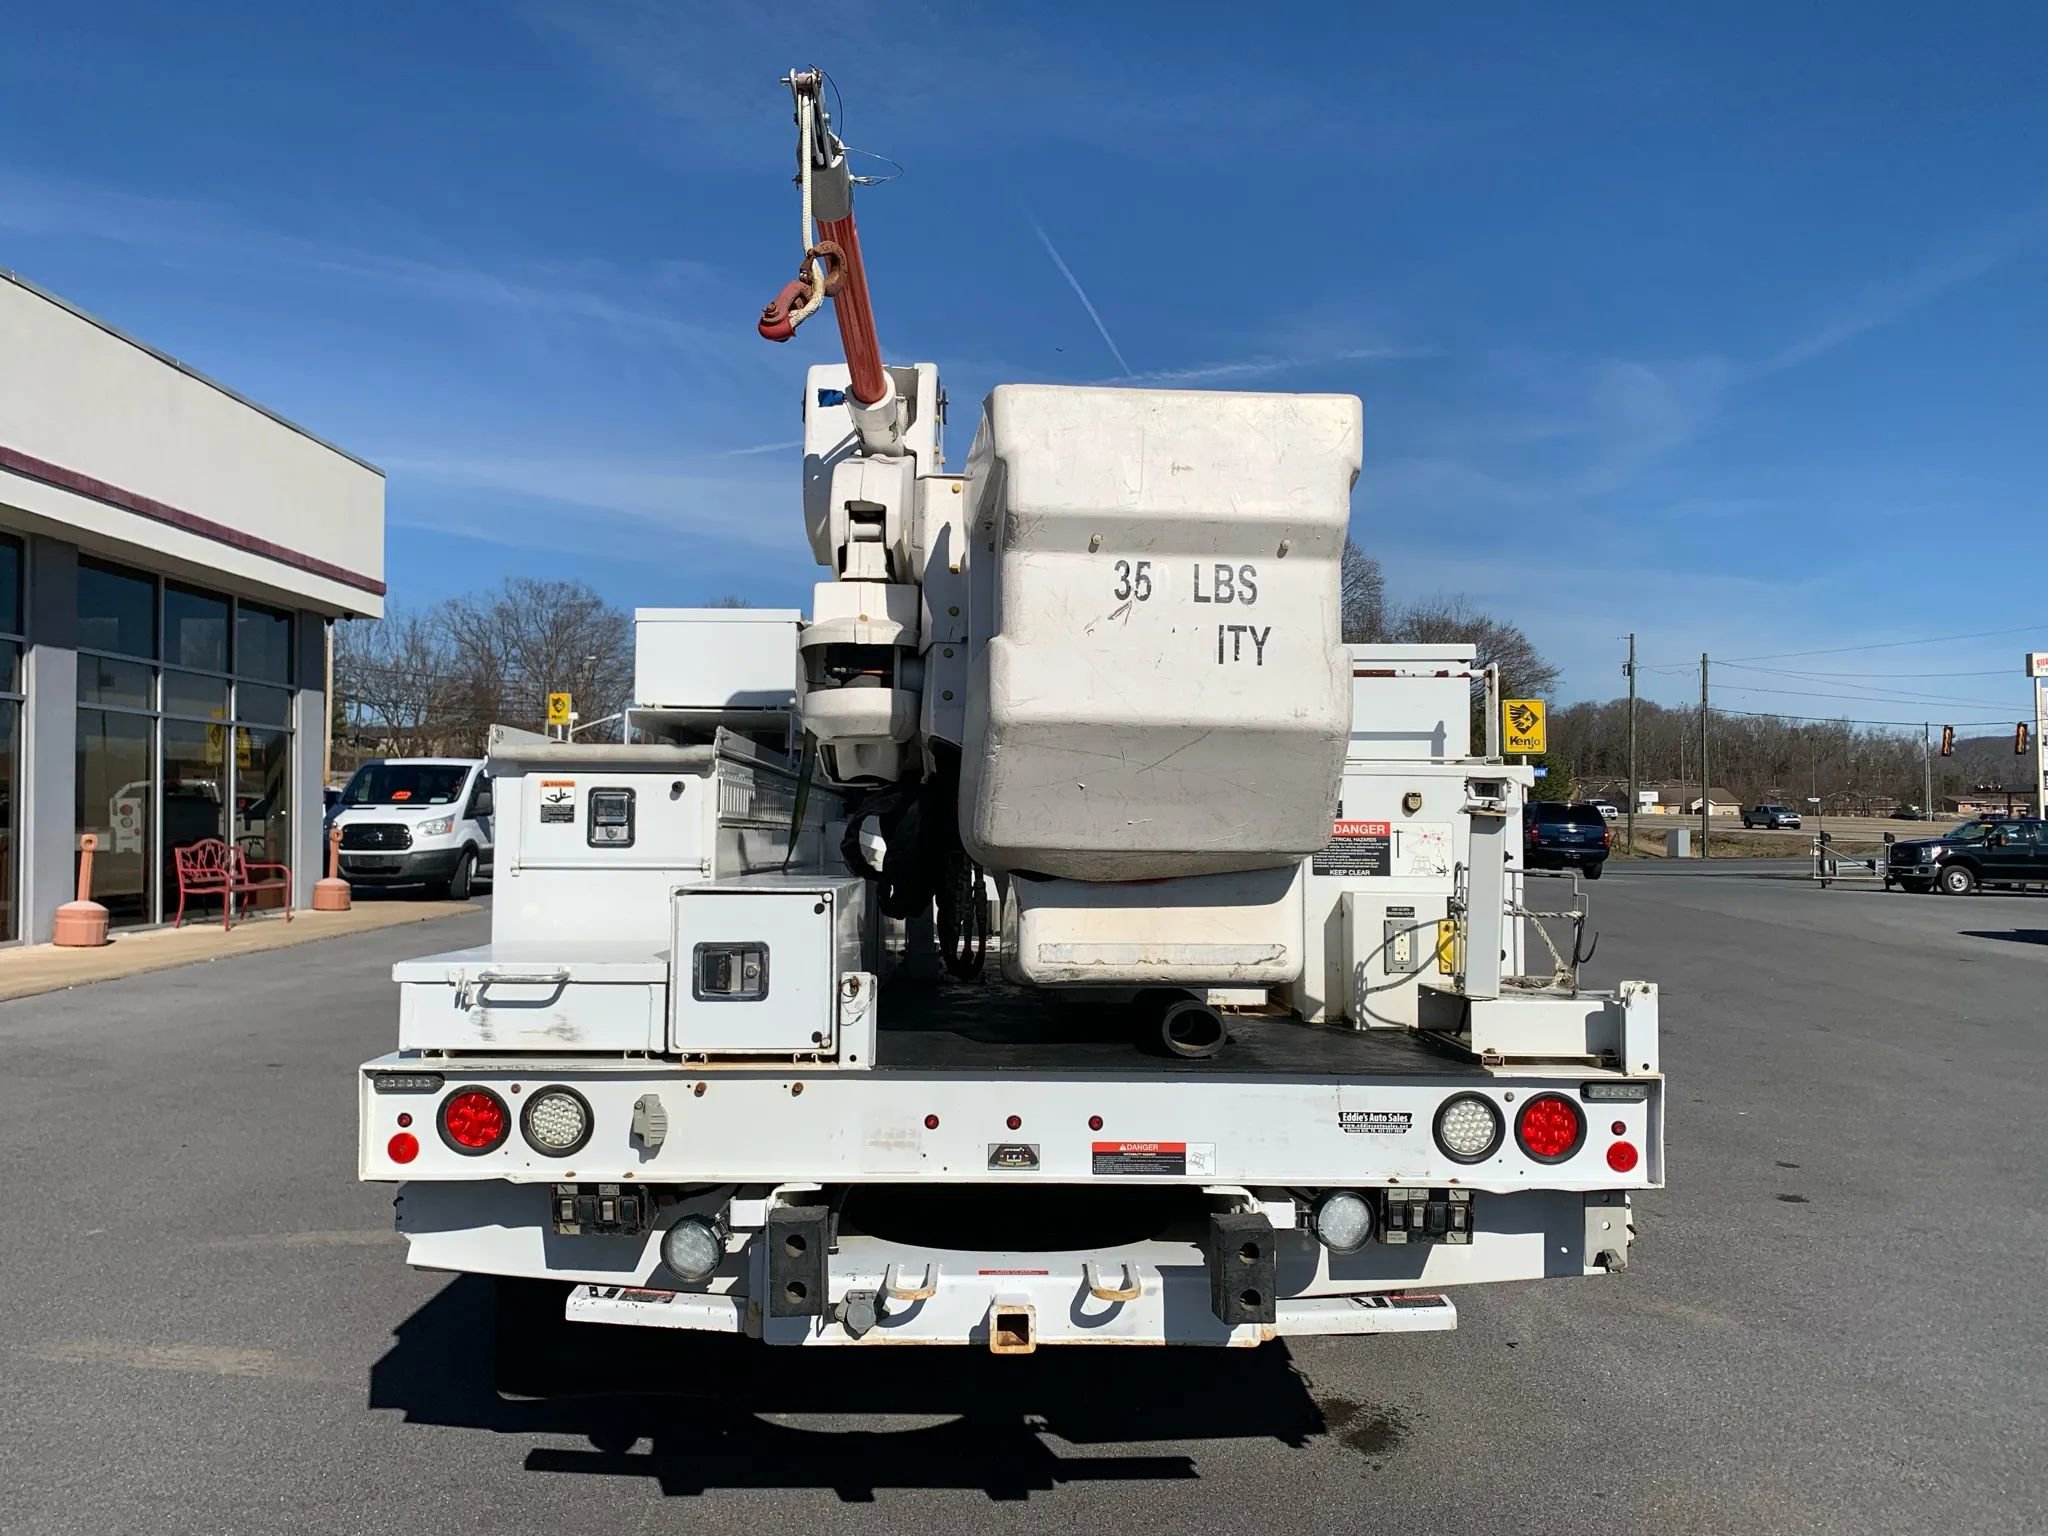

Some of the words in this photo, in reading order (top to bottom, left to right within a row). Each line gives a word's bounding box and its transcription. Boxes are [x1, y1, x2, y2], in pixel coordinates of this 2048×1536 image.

[1194, 563, 1257, 605] LBS
[1509, 736, 1540, 749] Kenjo
[1333, 824, 1386, 834] DANGER
[1342, 1112, 1368, 1122] Eddie's
[1369, 1113, 1387, 1122] Auto
[1388, 1113, 1408, 1122] Sales
